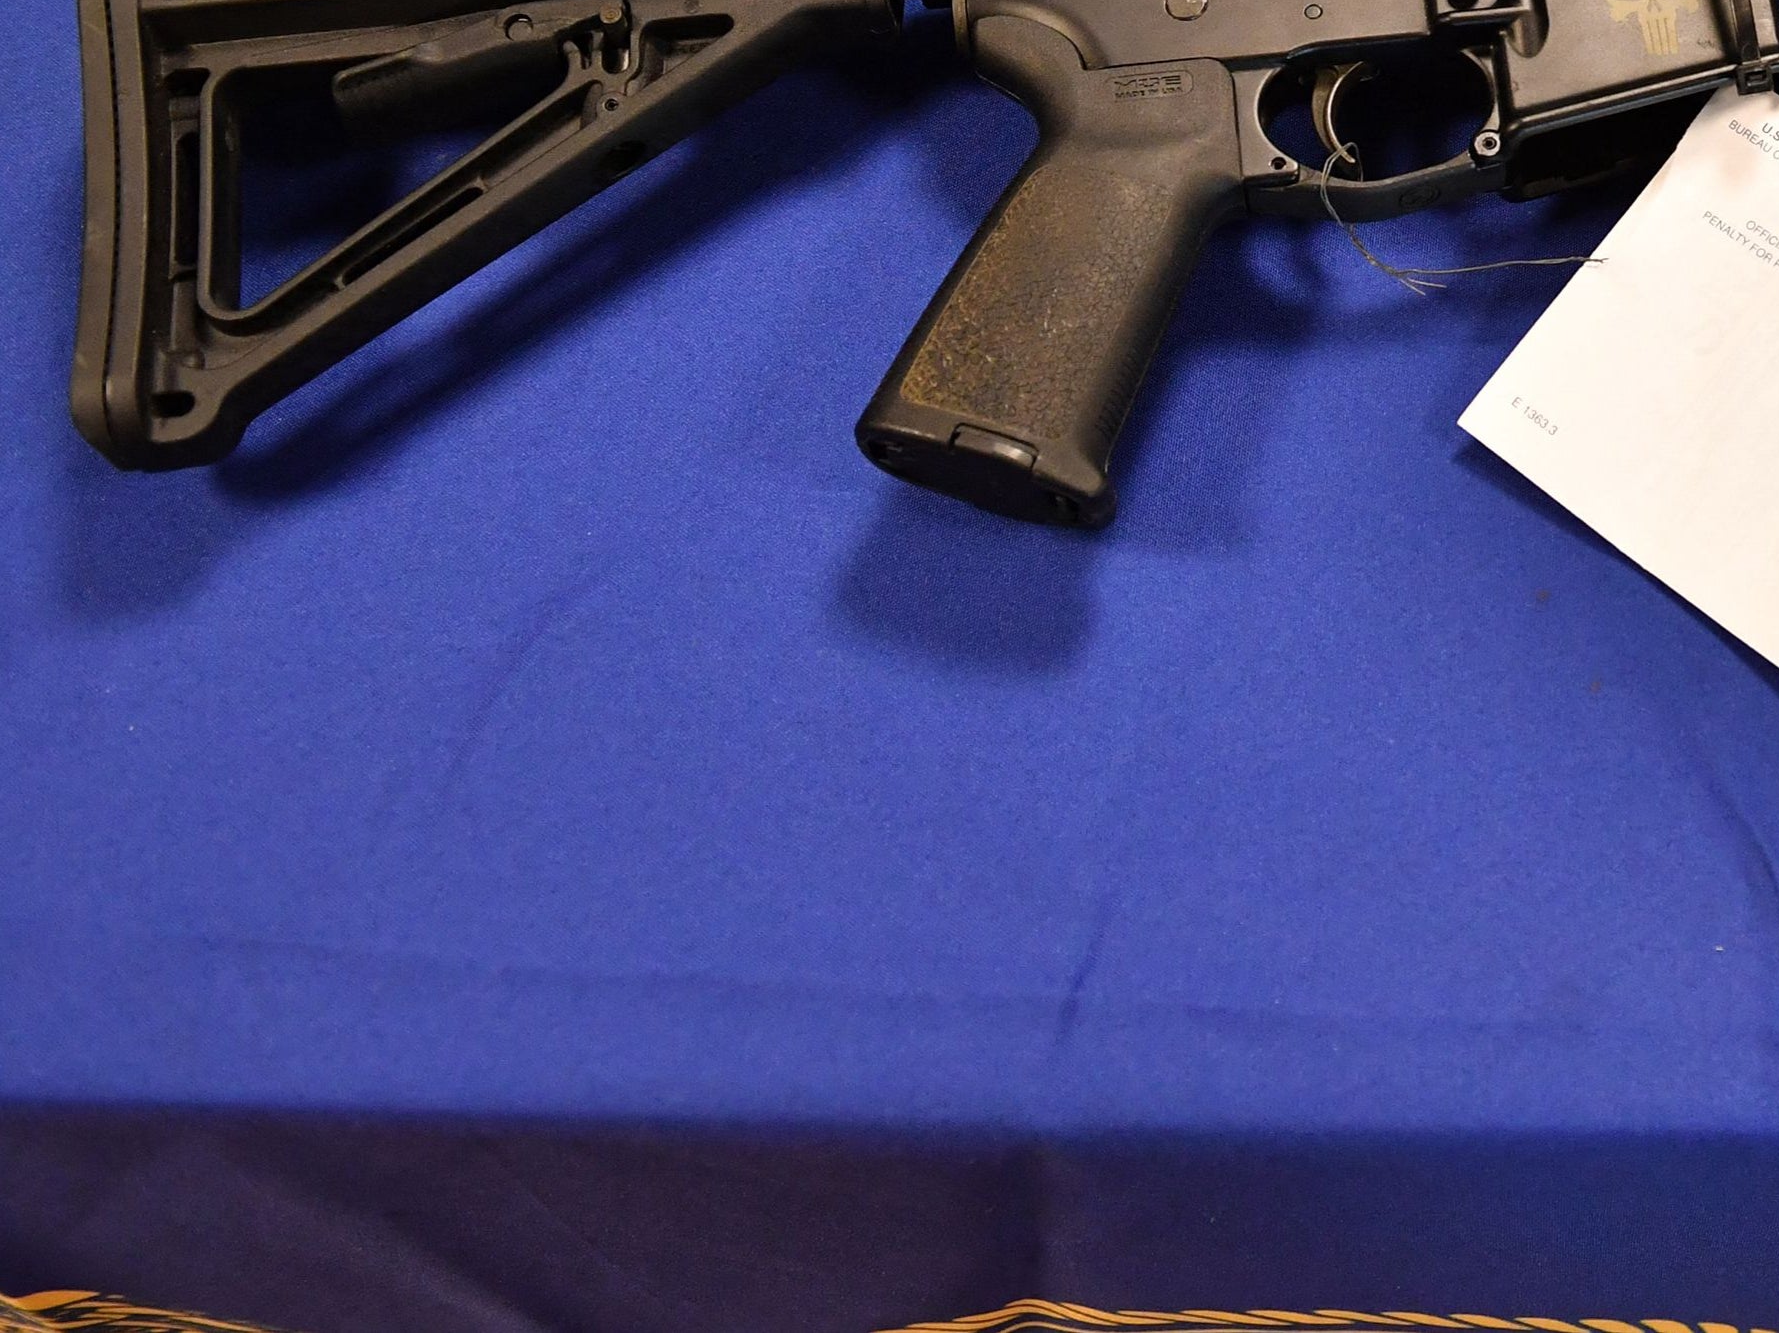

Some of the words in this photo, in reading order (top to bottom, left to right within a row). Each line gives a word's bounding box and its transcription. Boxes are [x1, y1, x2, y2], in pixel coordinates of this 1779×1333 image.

[1728, 119, 1772, 153] BUREAU
[1702, 210, 1750, 246] PENALTY
[1749, 243, 1774, 263] FOR
[1511, 396, 1523, 408] E
